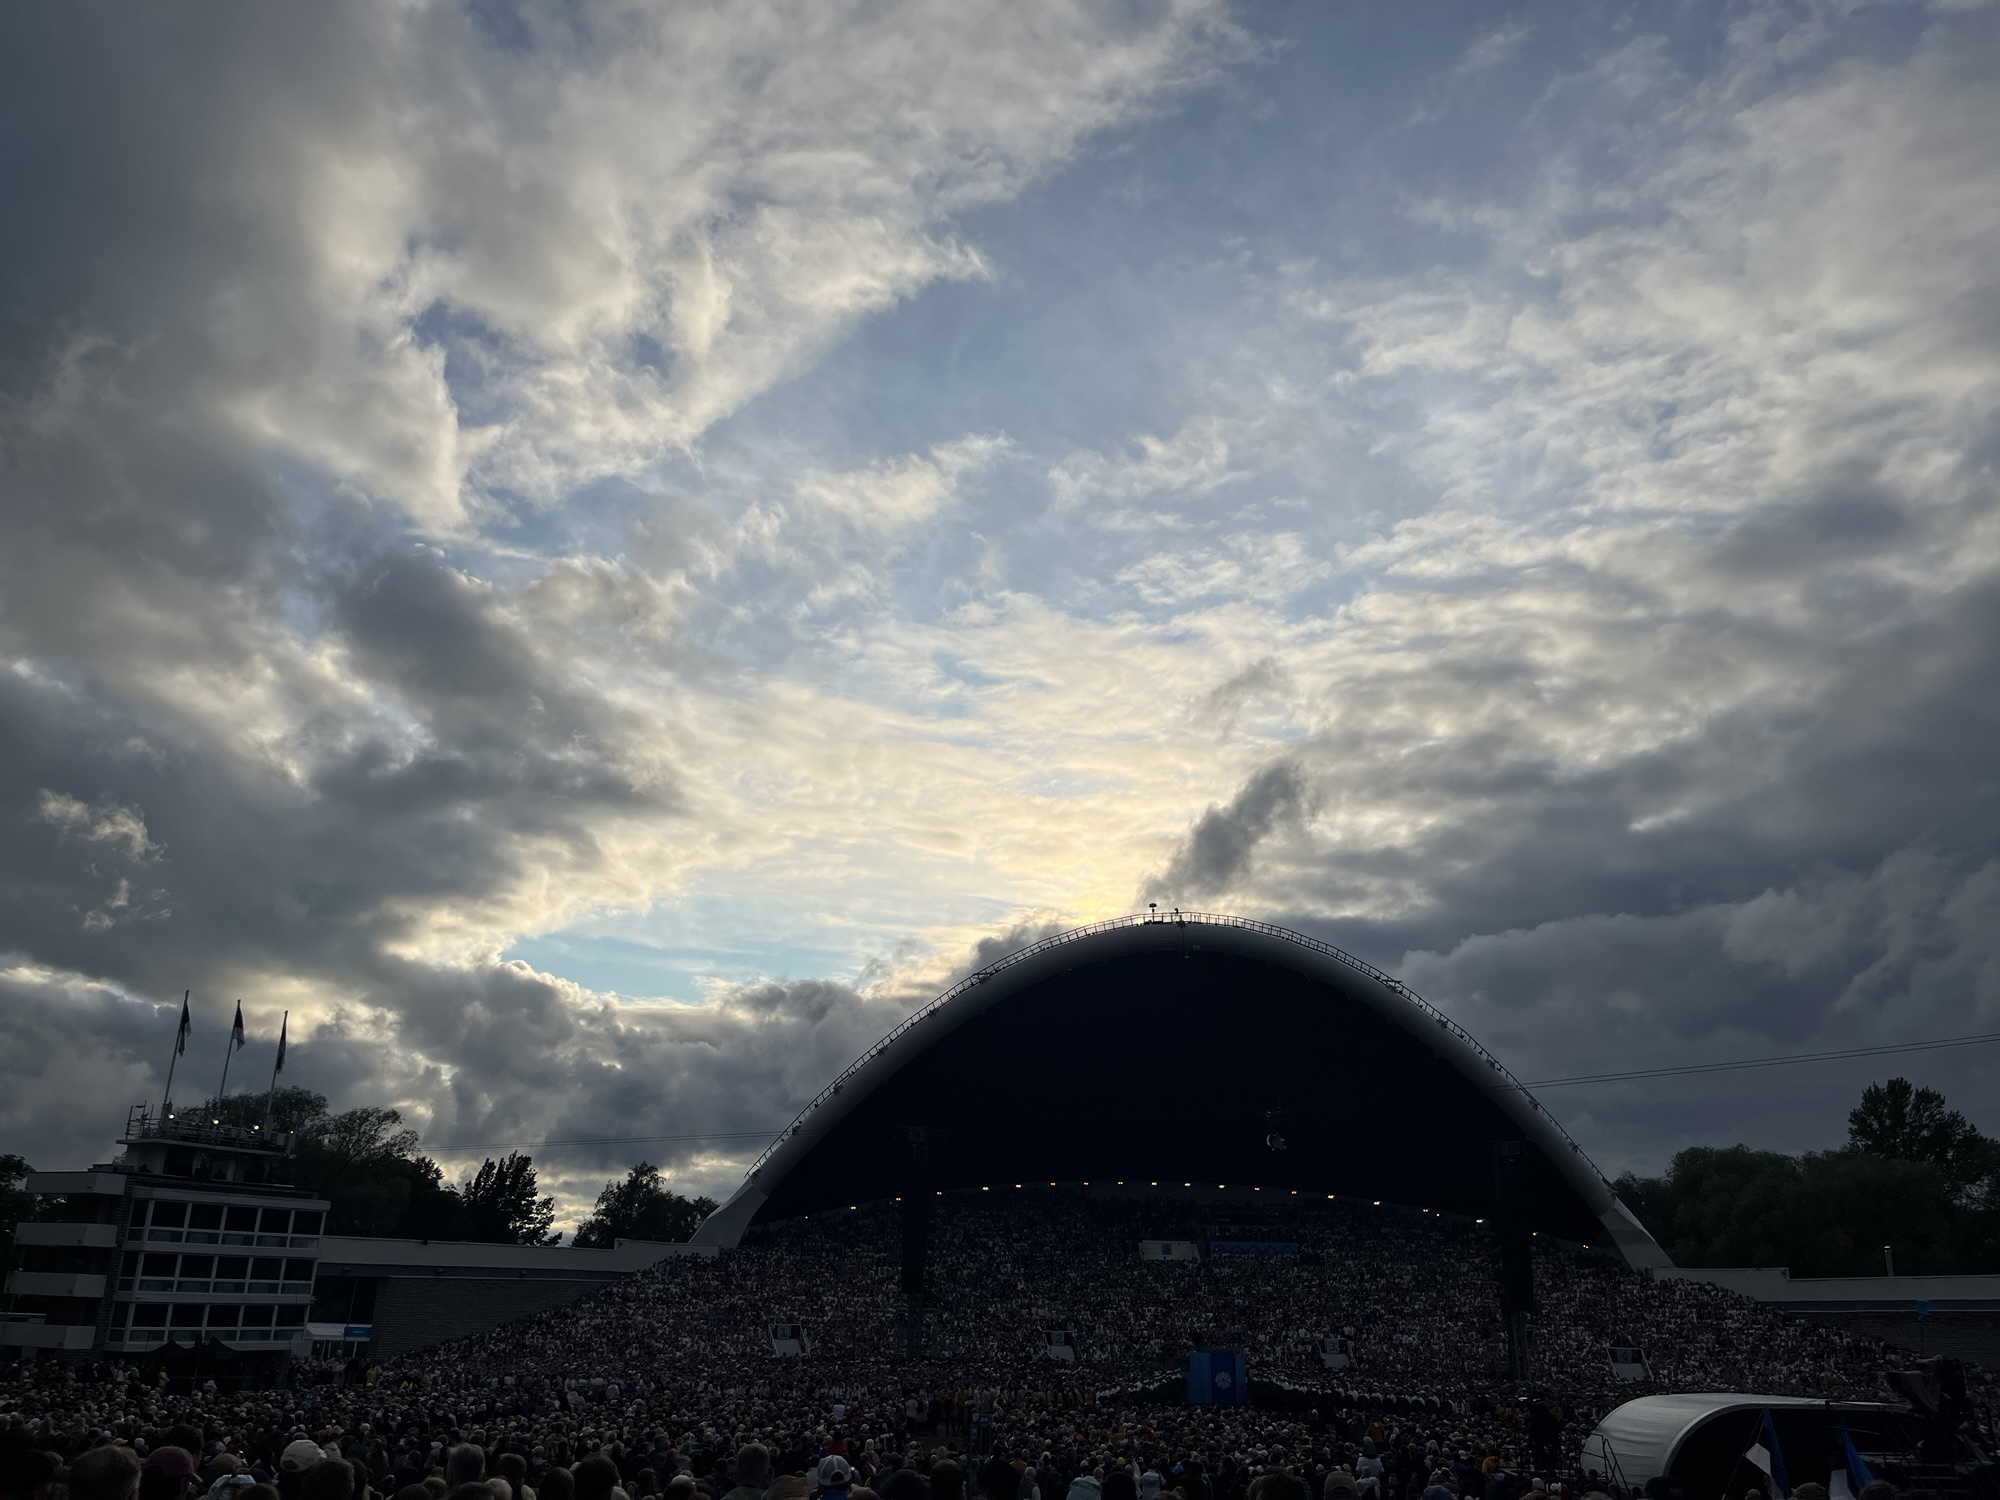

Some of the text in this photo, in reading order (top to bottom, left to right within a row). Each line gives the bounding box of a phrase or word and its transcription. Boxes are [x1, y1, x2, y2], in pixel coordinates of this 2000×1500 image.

[780, 1328, 786, 1338] 1
[1055, 1334, 1062, 1343] 2
[1329, 1342, 1336, 1351] 3
[1621, 1351, 1628, 1362] 4
